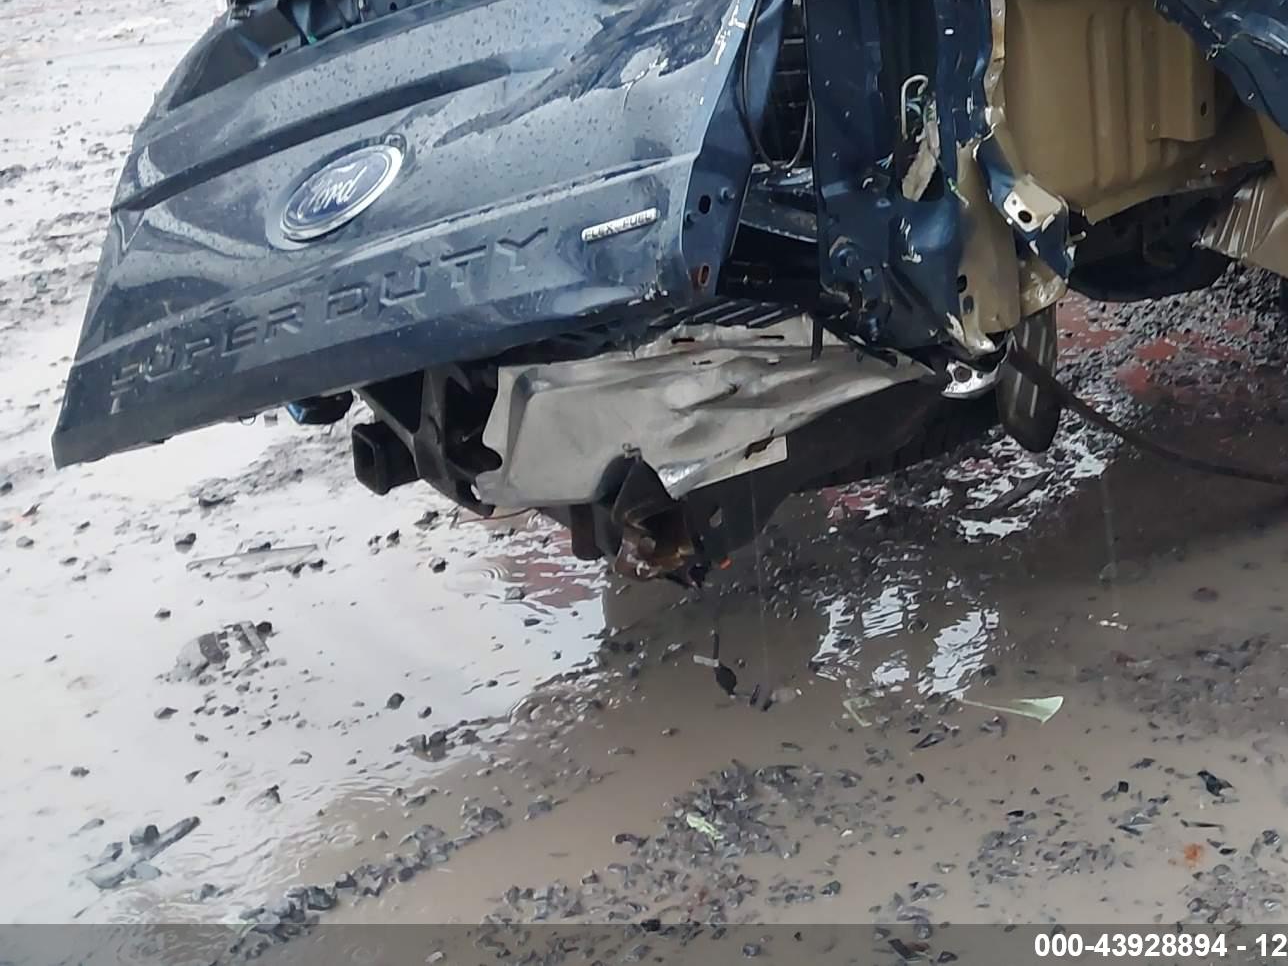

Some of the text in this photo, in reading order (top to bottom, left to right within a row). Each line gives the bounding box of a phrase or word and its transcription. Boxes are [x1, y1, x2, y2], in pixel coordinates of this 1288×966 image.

[289, 163, 368, 220] Ford
[109, 226, 549, 415] SUPER DUTY
